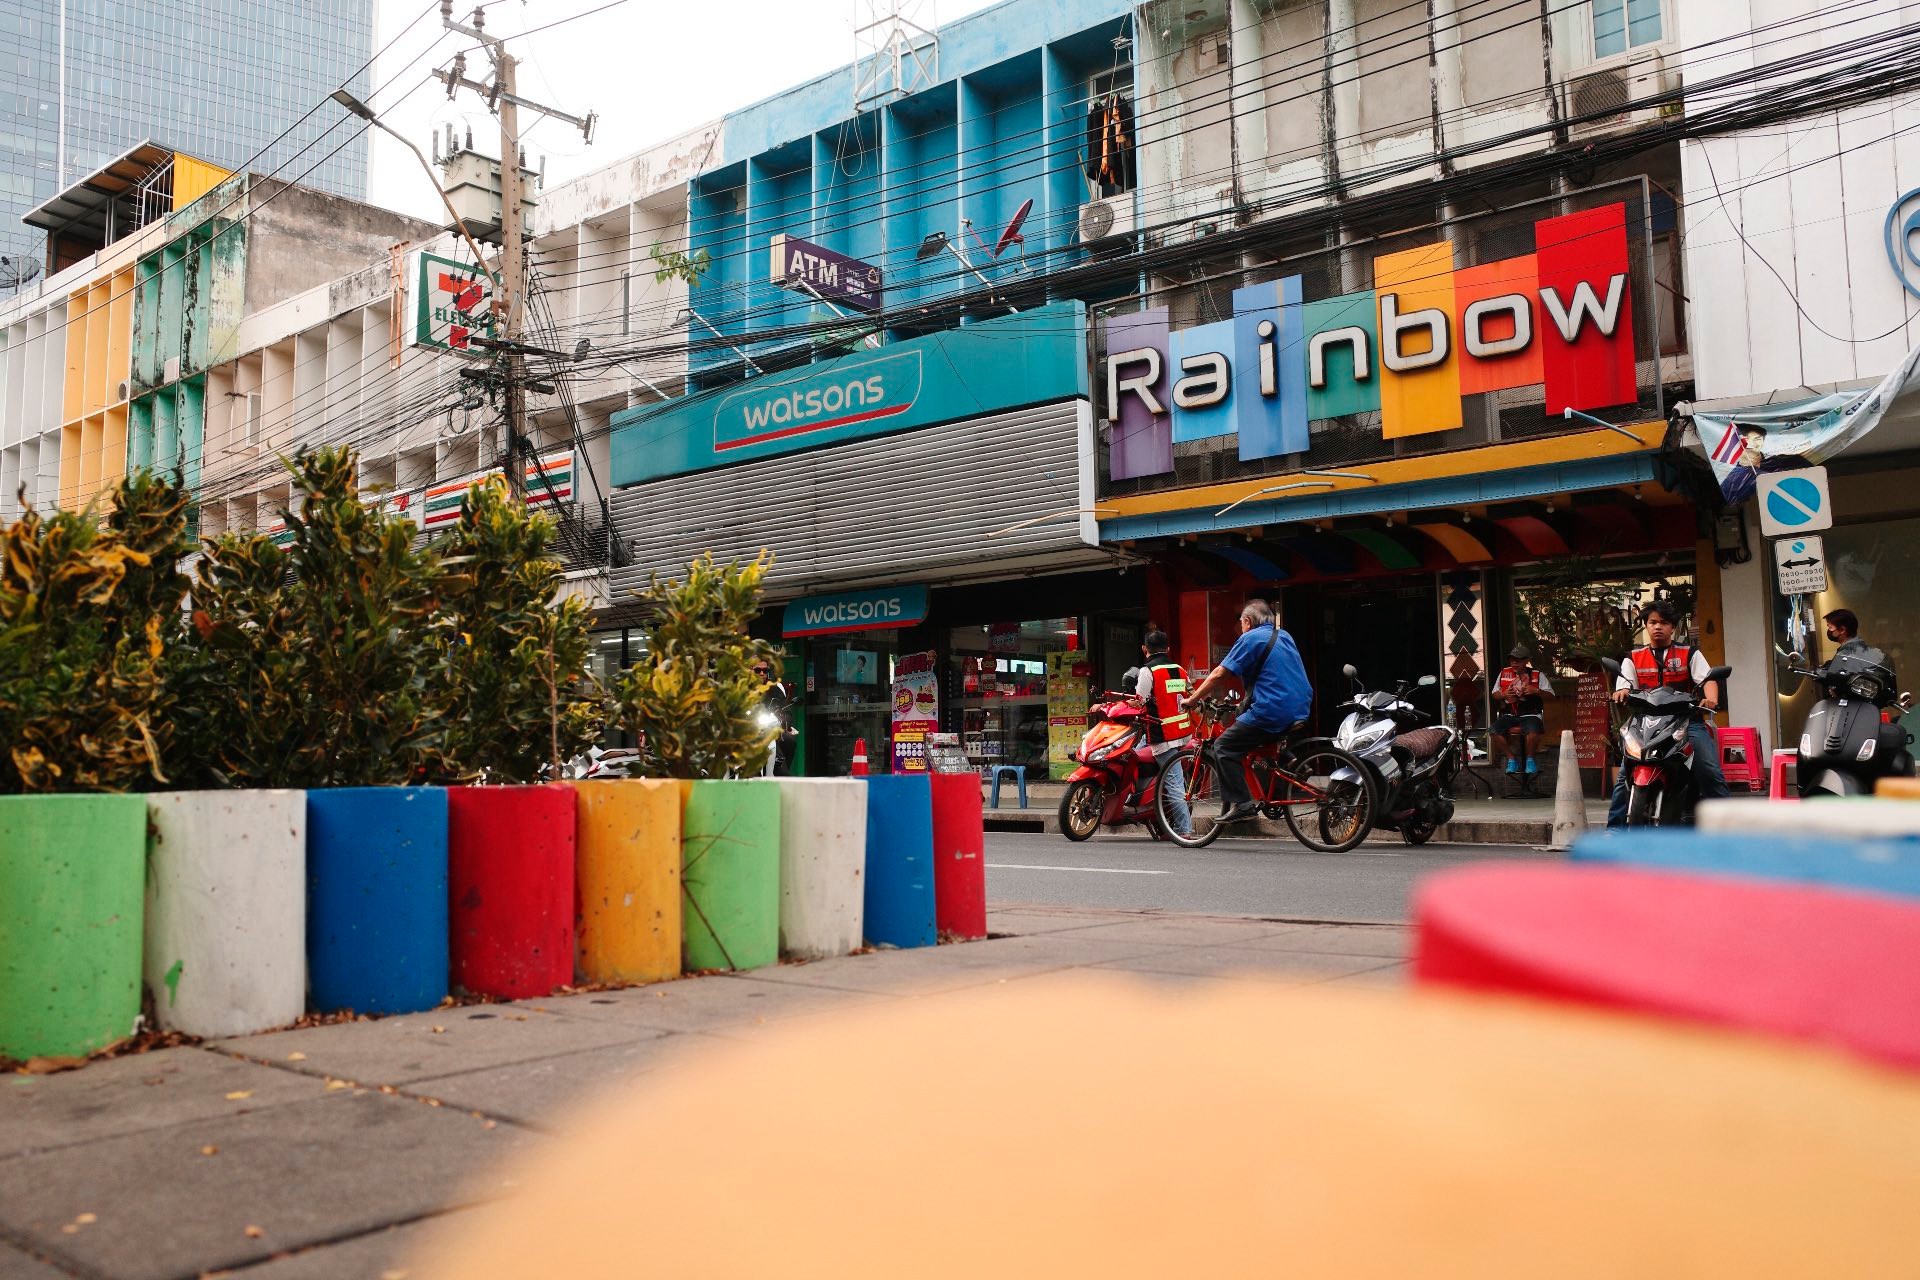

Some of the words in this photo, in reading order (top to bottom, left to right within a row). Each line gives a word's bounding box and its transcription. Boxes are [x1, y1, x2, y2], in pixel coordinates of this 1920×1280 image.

[790, 249, 838, 288] ATM
[1106, 273, 1628, 422] Rainbow
[743, 375, 884, 430] watsons
[804, 597, 901, 625] watsons
